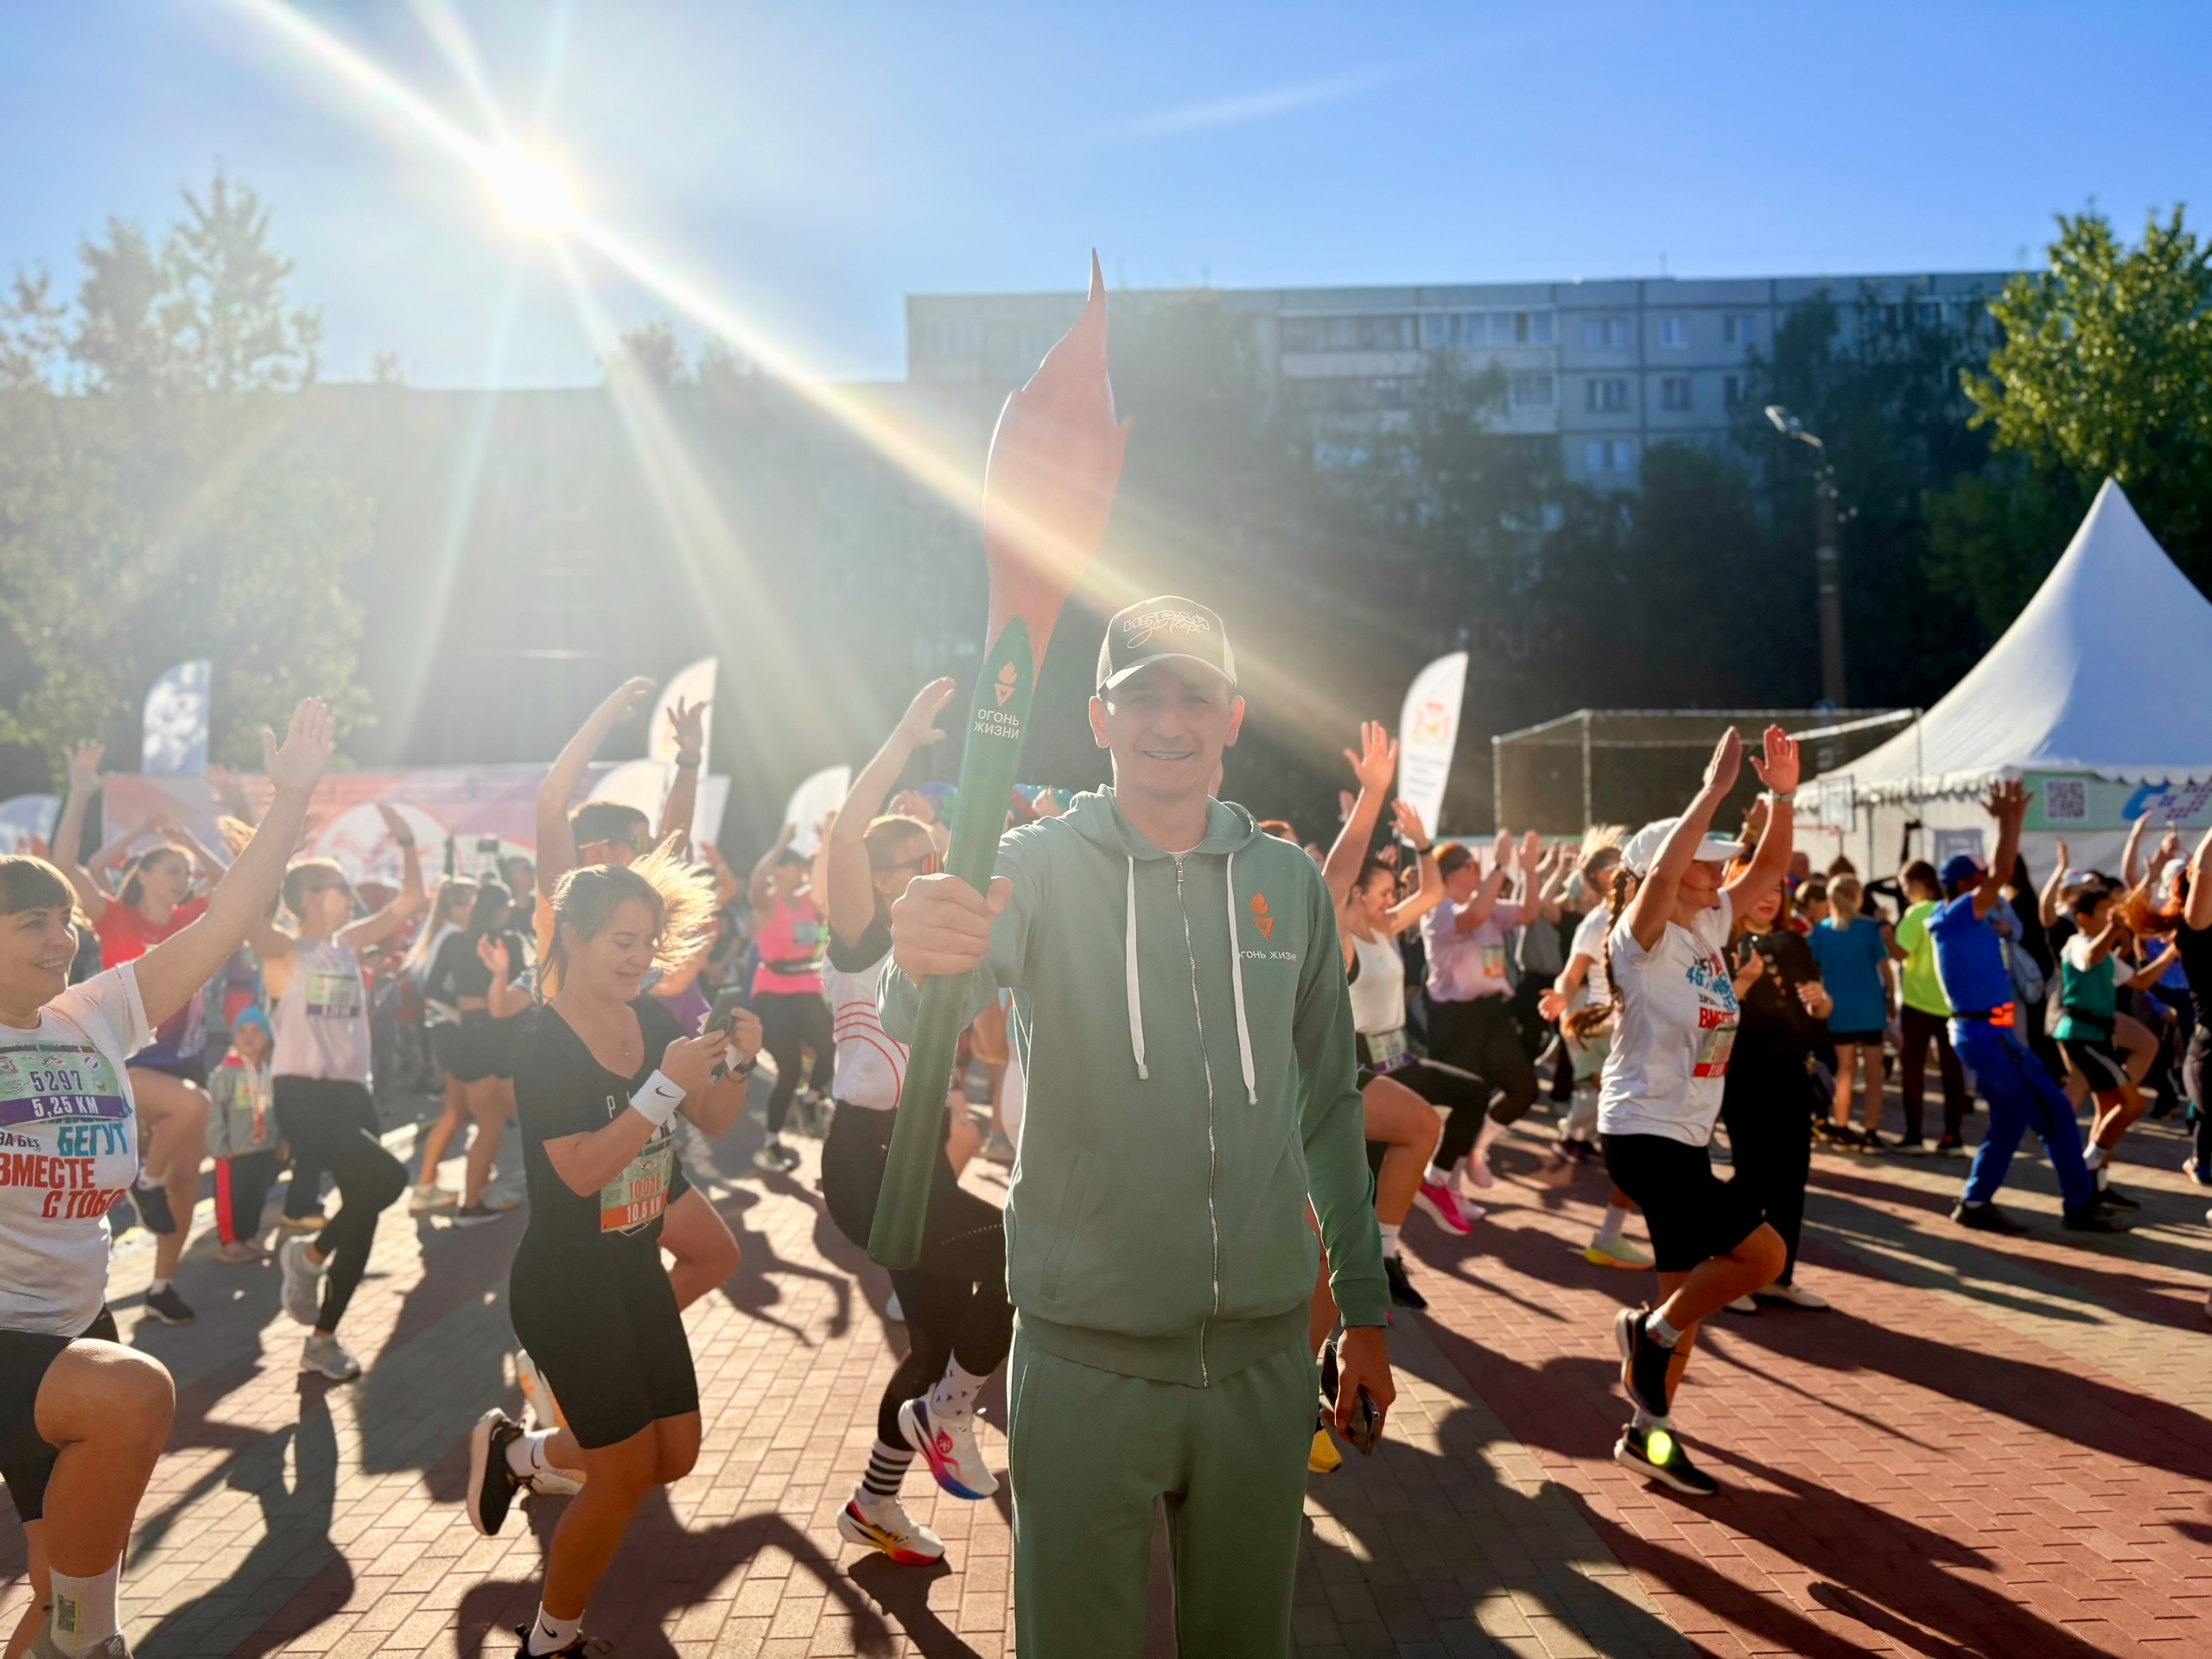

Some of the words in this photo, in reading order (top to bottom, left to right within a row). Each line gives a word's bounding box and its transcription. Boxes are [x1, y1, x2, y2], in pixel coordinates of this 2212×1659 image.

[977, 709, 1020, 726] ОГОНЬ
[973, 721, 1020, 740] ЖИЗНИ
[29, 1070, 84, 1093] 5297
[31, 1096, 73, 1117] 5,25
[57, 1122, 129, 1157] БЕГУТ
[0, 1153, 96, 1189] ВМЕСТЕ
[41, 1190, 64, 1218] С
[64, 1188, 127, 1219] ТОБО
